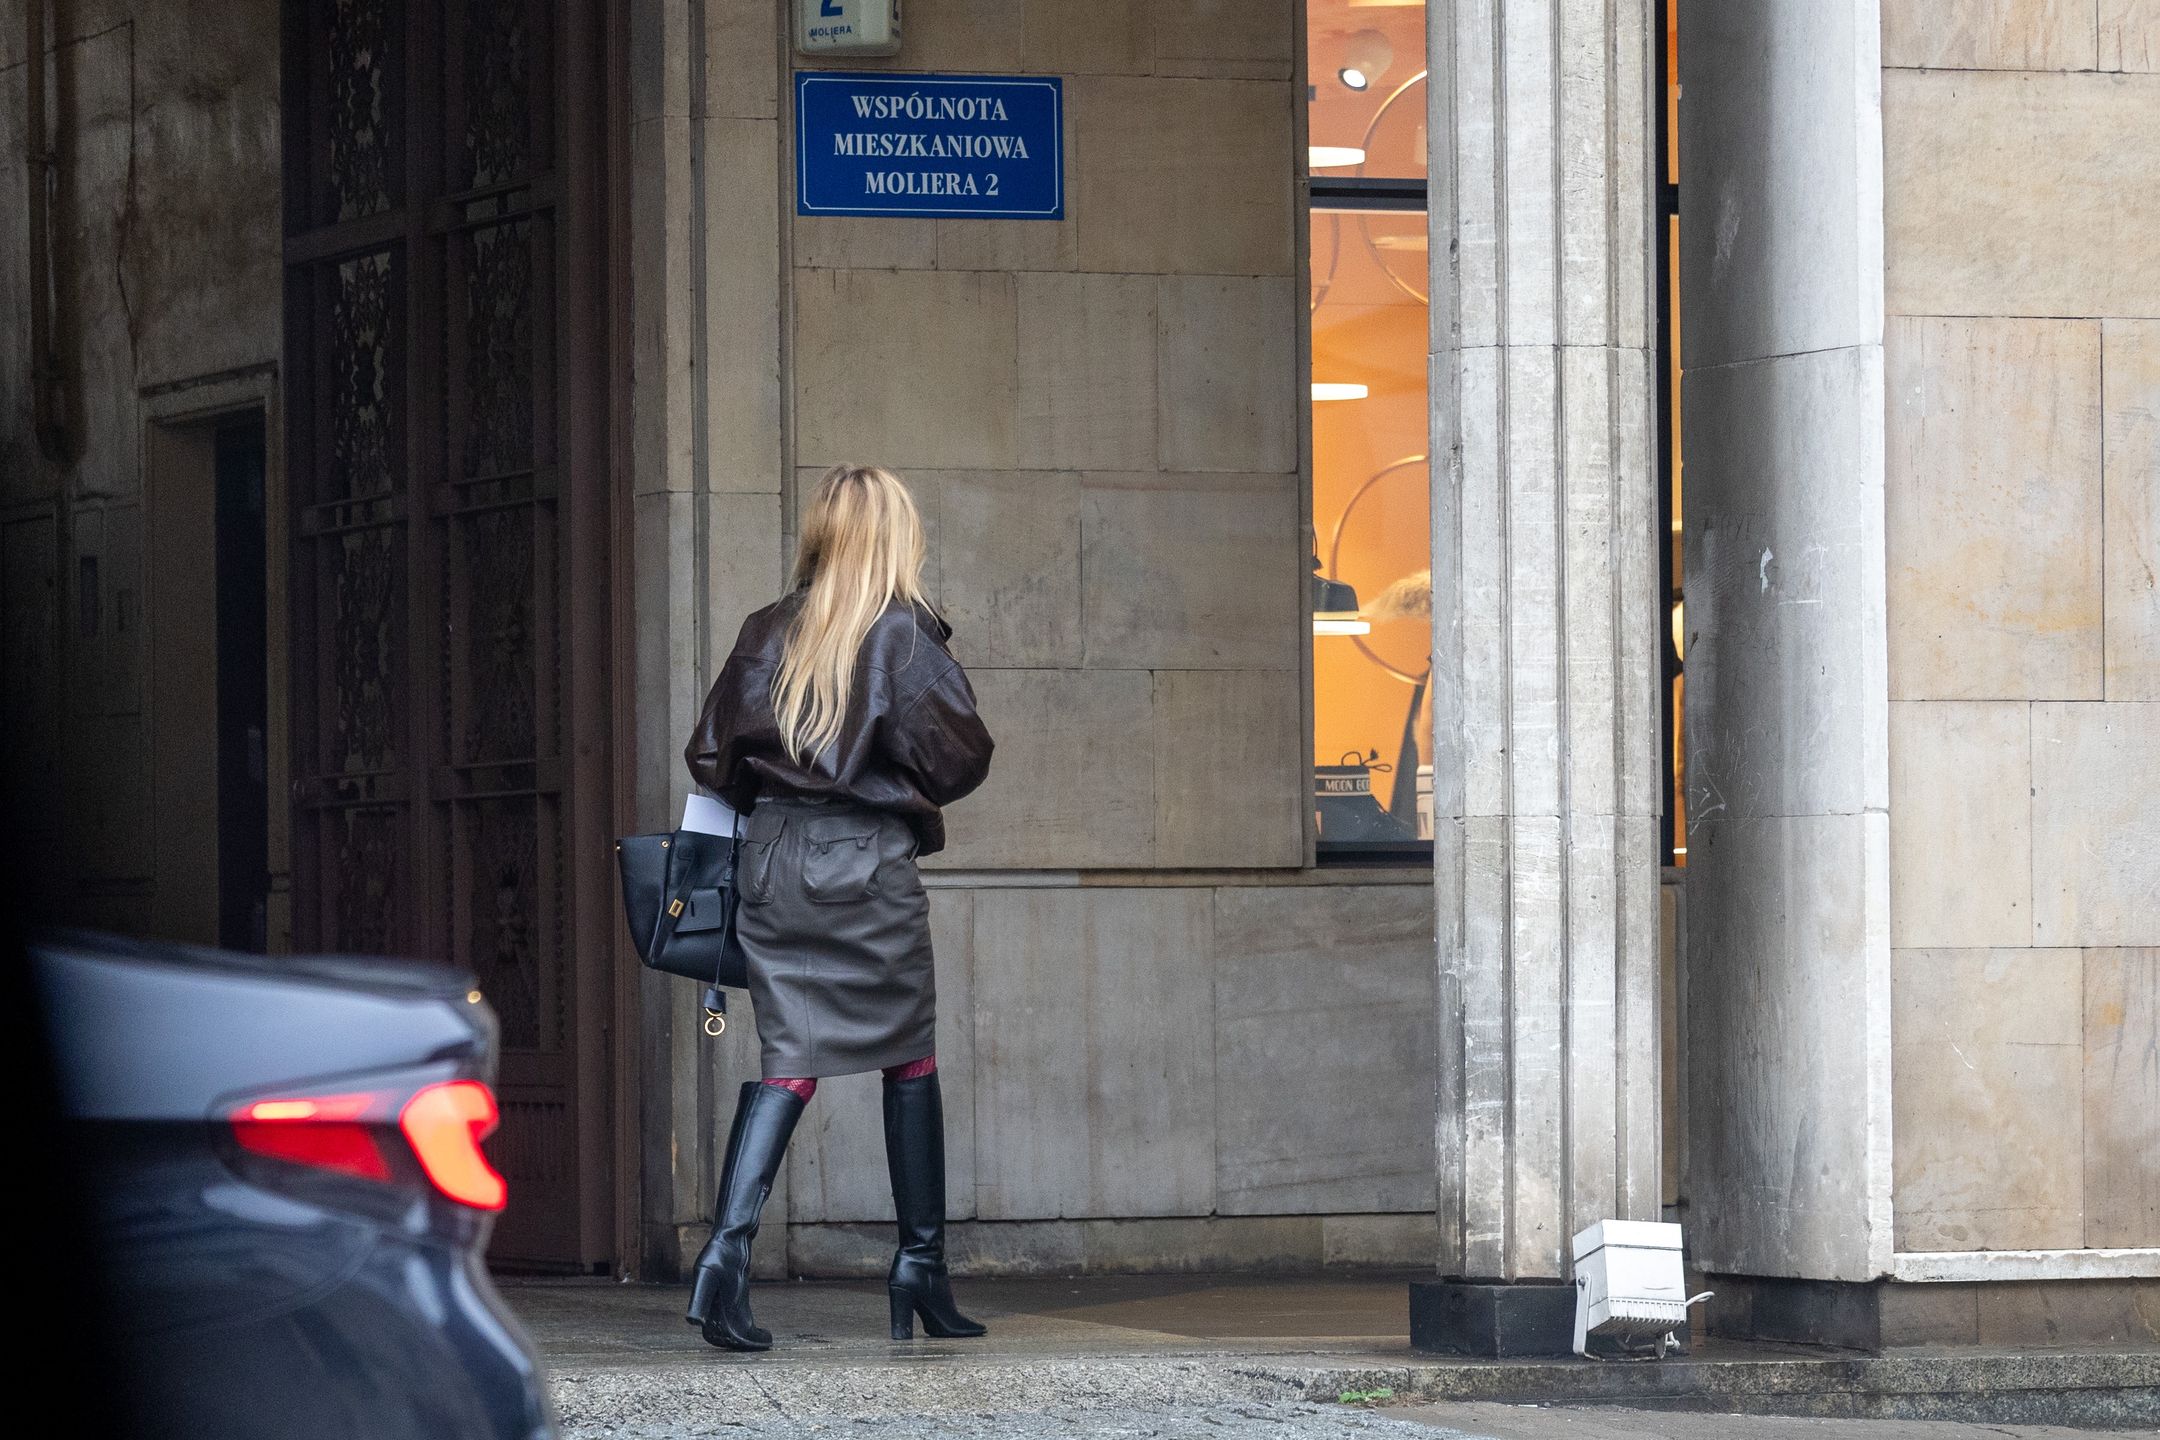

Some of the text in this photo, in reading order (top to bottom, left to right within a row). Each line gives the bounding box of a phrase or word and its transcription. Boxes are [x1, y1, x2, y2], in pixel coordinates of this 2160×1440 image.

[808, 26, 852, 37] MOLIERA
[851, 92, 1008, 121] WSPÓLNOTA
[833, 133, 1029, 159] MIESZKANIOWA
[865, 172, 999, 196] MOLIERA 2
